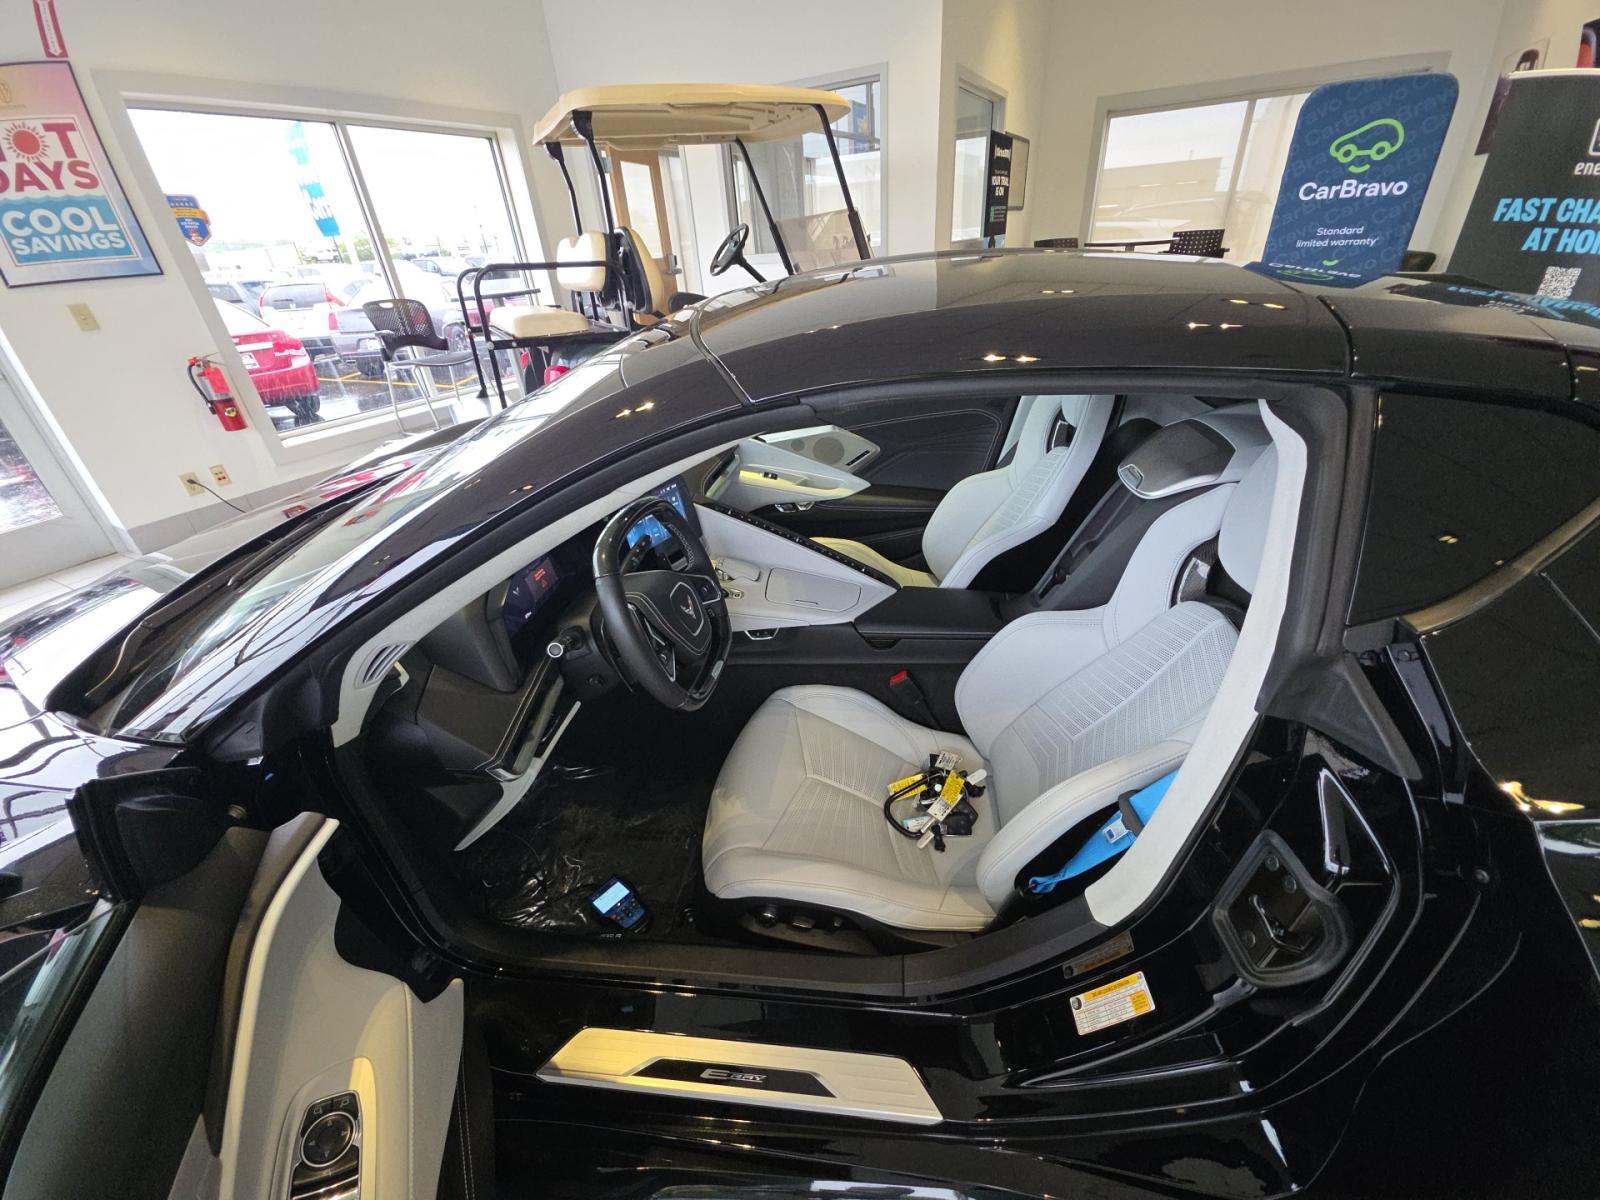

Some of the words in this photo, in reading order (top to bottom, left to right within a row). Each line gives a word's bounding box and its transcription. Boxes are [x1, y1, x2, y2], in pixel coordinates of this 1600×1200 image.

[0, 121, 77, 162] OT
[1298, 179, 1408, 200] CarBravo
[1493, 197, 1558, 222] FAST
[2, 206, 120, 237] COOL
[1316, 226, 1364, 236] Standard
[11, 232, 126, 255] SAVINGS
[1296, 238, 1328, 248] limited
[1521, 227, 1558, 251] AT
